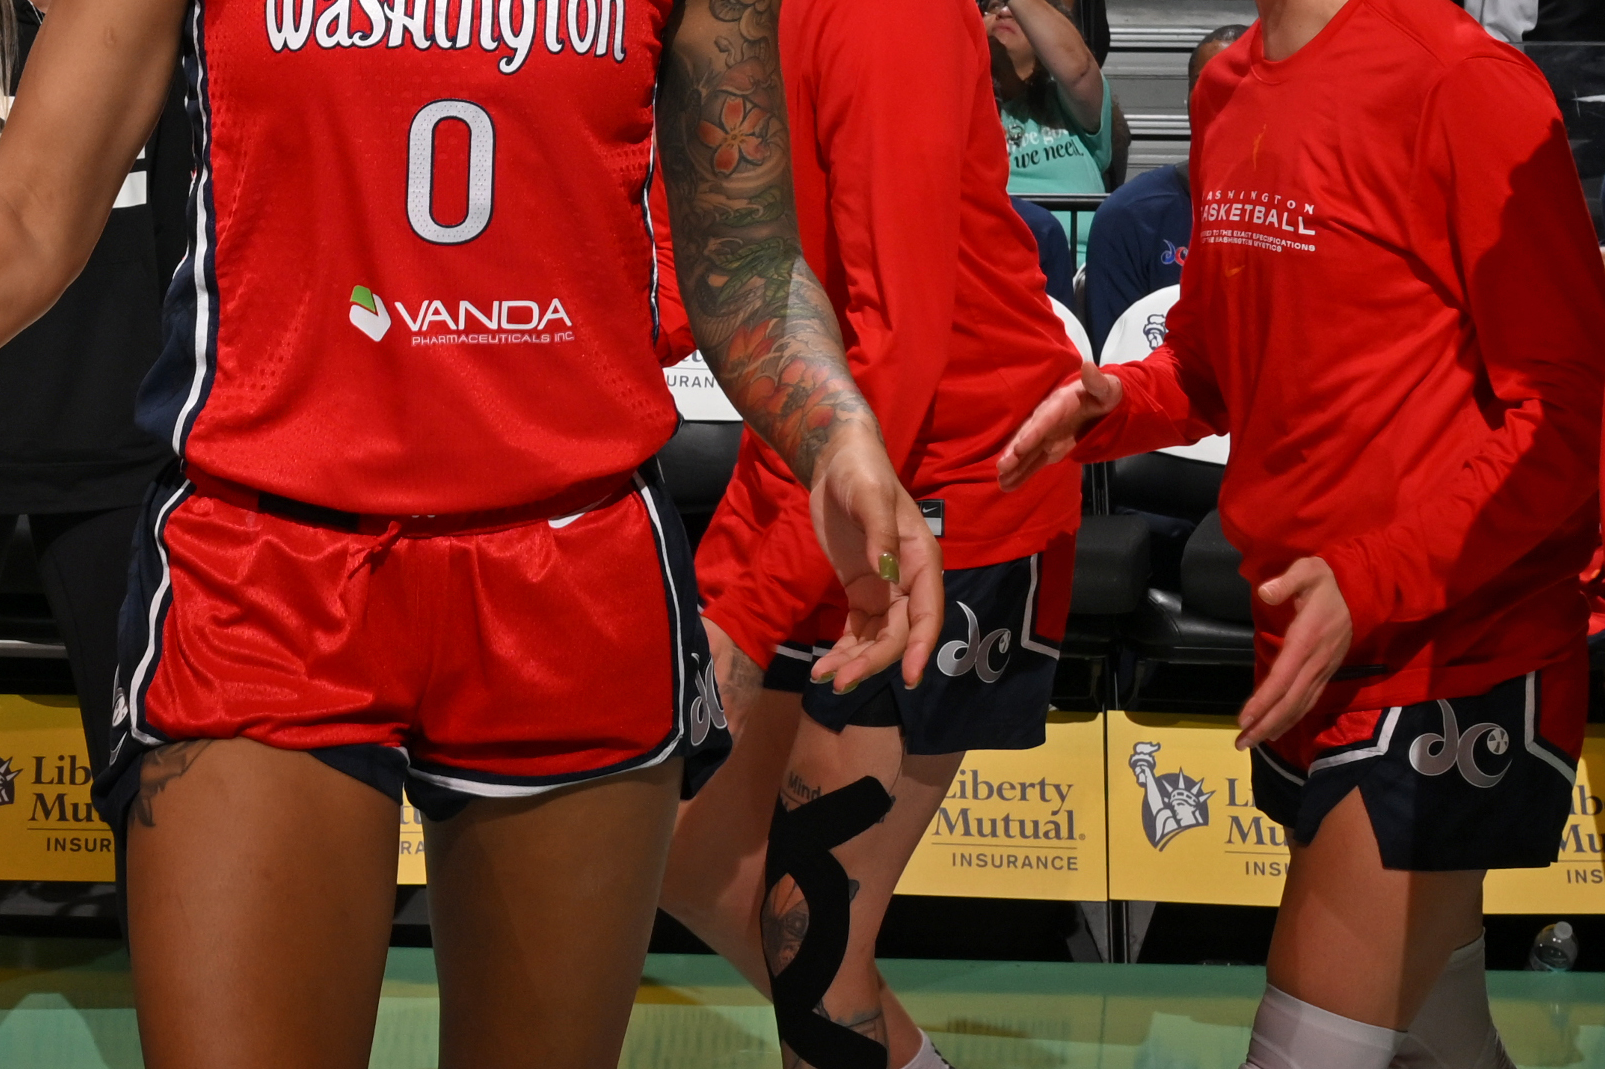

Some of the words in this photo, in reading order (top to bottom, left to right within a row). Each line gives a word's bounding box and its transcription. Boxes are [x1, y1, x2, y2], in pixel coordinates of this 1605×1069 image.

[406, 98, 495, 246] 0
[1202, 189, 1315, 216] ASHINGTON
[394, 297, 573, 332] VANDA
[411, 333, 550, 347] PHARMACEUTICALS
[932, 806, 1077, 842] Mutual
[46, 836, 112, 852] INSUR
[952, 852, 1079, 872] INSURANCE
